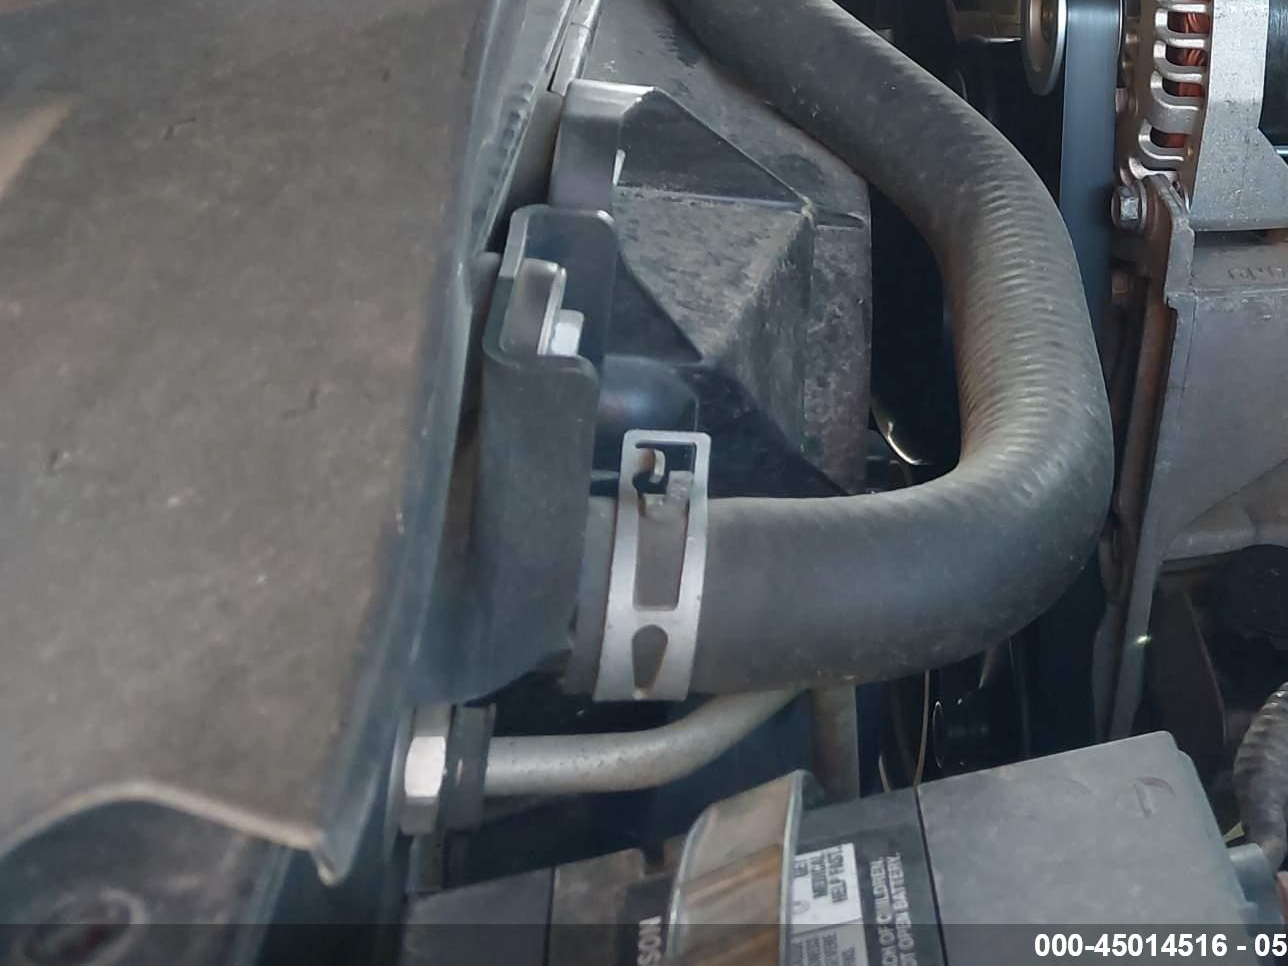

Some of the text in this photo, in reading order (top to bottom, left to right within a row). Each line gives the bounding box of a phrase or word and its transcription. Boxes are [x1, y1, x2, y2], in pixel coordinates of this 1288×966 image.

[811, 853, 828, 899] MEDICAL
[829, 877, 848, 903] HELP
[878, 925, 896, 947] OF
[895, 912, 914, 951] OPEN
